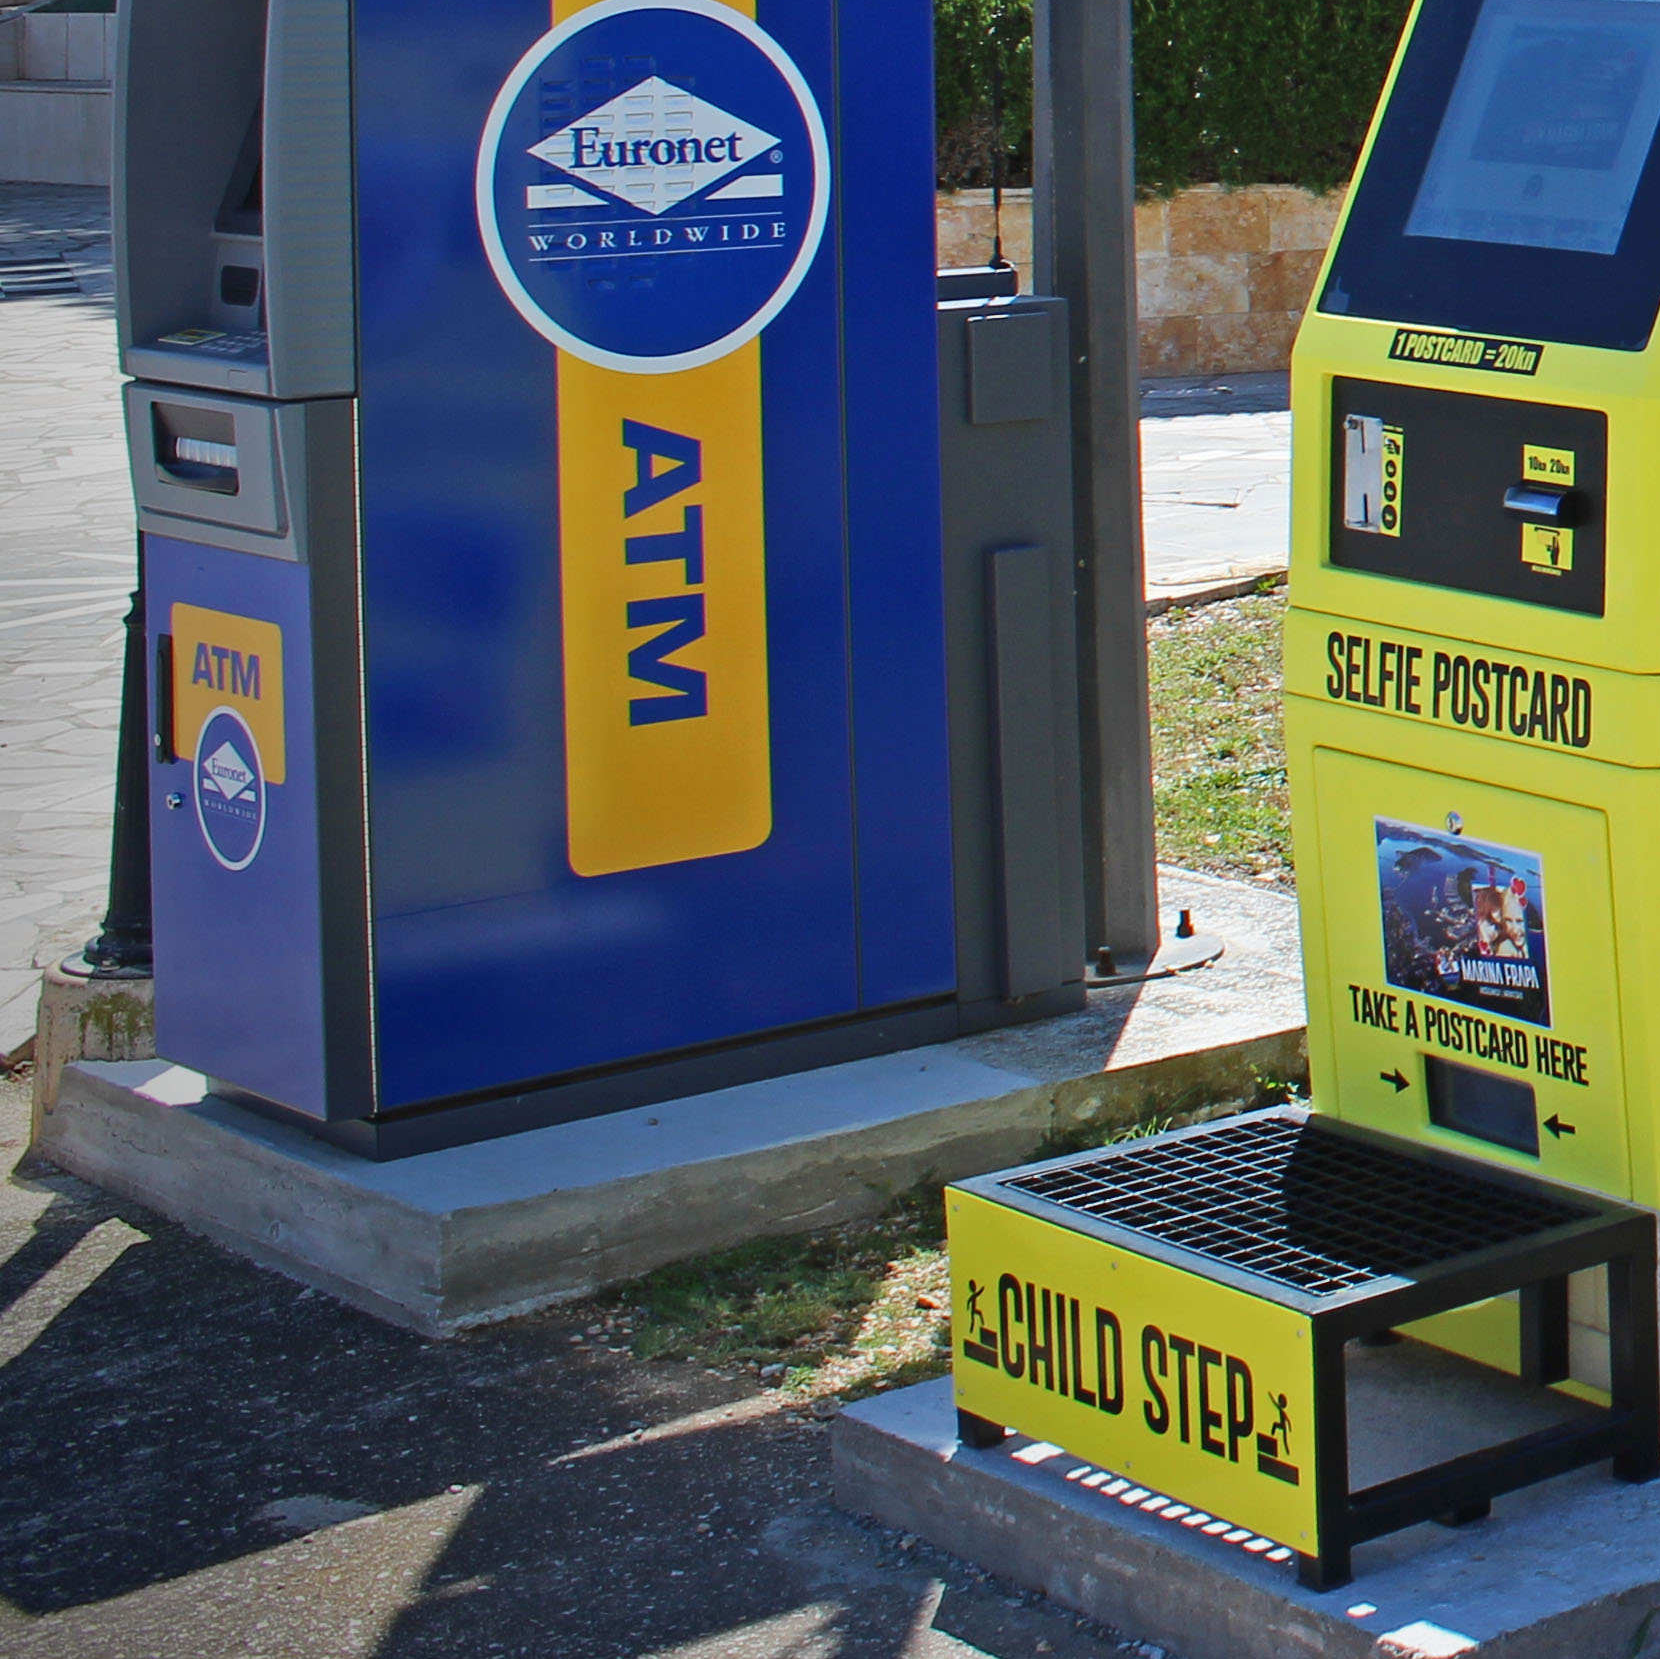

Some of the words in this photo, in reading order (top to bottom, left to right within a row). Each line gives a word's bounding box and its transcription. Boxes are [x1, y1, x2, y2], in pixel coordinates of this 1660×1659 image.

[569, 126, 743, 169] Euronet
[529, 222, 786, 252] WORLDWIDE
[1403, 333, 1485, 365] POSTCARD
[622, 417, 707, 727] ATM
[193, 641, 260, 701] ATM
[1326, 631, 1423, 715] SELFIE
[1433, 651, 1592, 748] POSTCARD
[211, 757, 247, 784] Euronet
[1461, 956, 1504, 986] MARINA
[1504, 963, 1540, 989] FRAPA
[1349, 984, 1400, 1034] TAKE
[1405, 1000, 1420, 1039] A
[1424, 1004, 1529, 1070] POSTCARD
[1535, 1035, 1590, 1087] HERE
[997, 1271, 1124, 1416] CHILD
[1142, 1324, 1255, 1464] STEP
